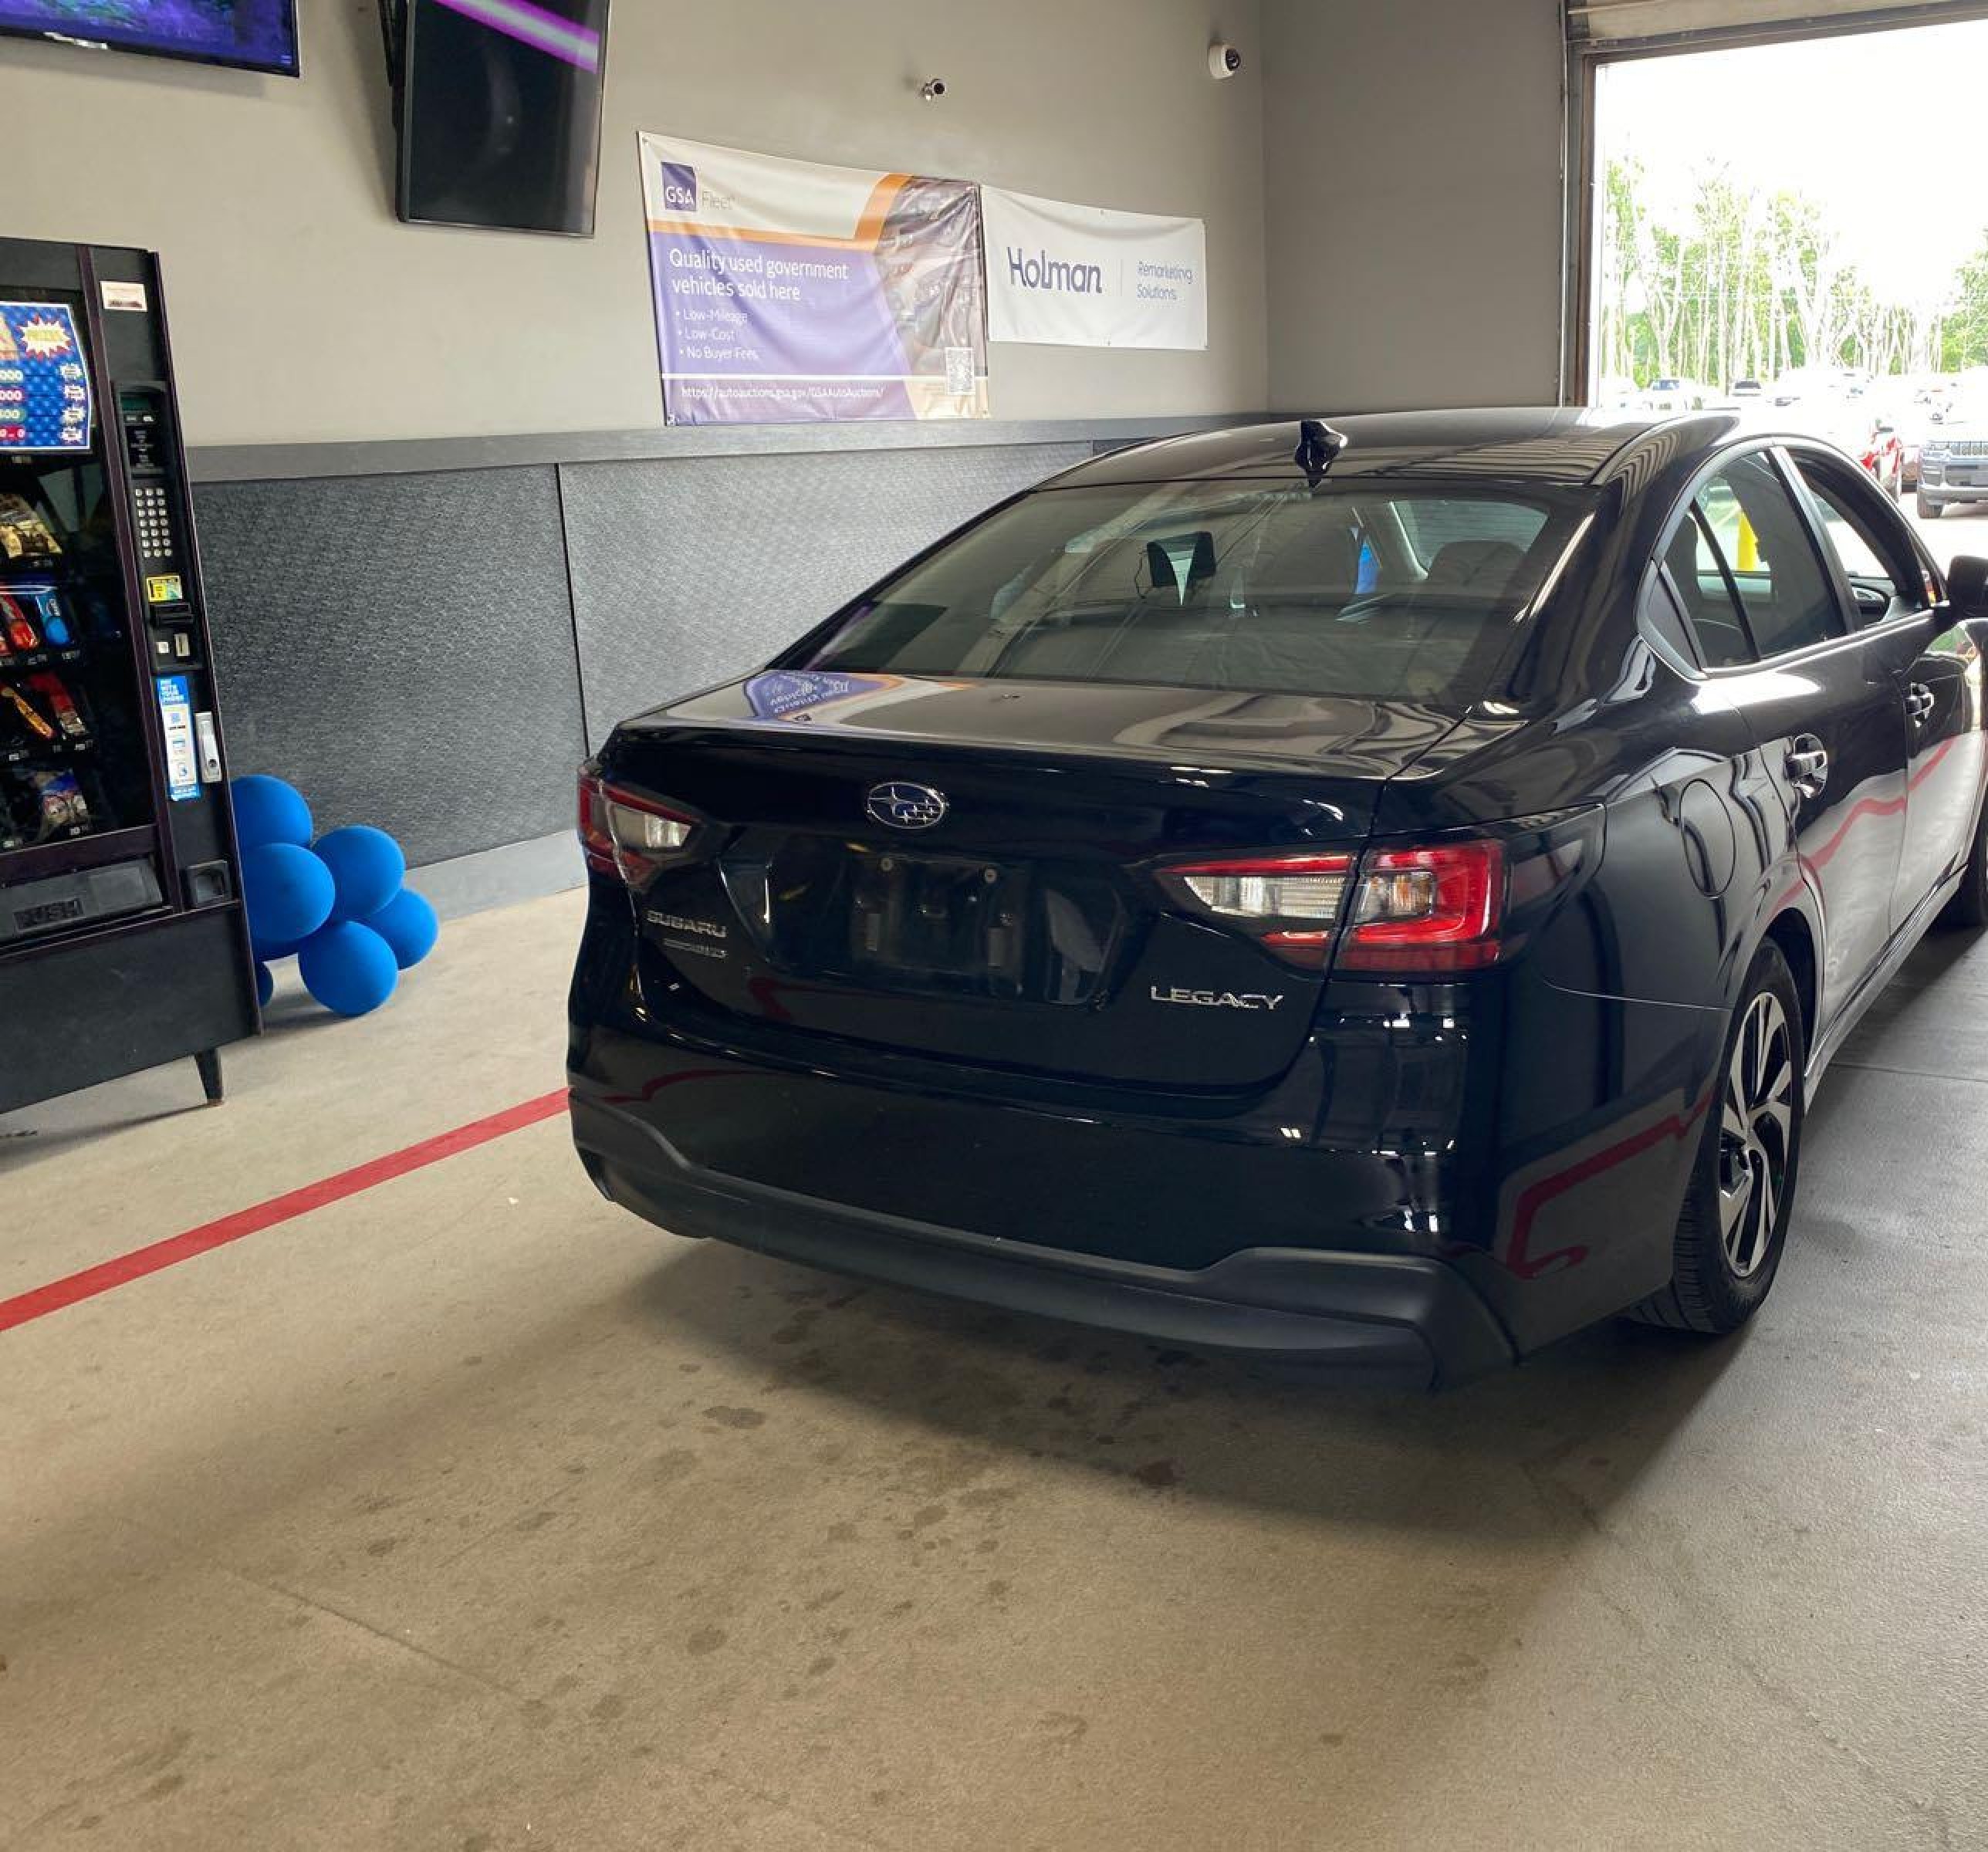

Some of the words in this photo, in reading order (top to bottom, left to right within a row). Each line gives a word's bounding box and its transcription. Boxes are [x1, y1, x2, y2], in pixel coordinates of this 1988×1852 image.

[666, 186, 694, 204] GSA
[669, 248, 724, 274] Quality
[730, 255, 762, 272] used
[766, 259, 848, 279] government
[1007, 246, 1103, 293] Holman
[1138, 261, 1193, 284] Remarketing
[672, 275, 734, 296] vehicles
[738, 279, 766, 297] sold
[770, 280, 800, 300] here
[1137, 284, 1177, 299] Solutions
[683, 309, 748, 325] Low-Mileage
[685, 327, 735, 341] Low-Cost
[687, 347, 703, 359] No
[704, 346, 732, 362] Buyer
[647, 910, 726, 938] SUBARU
[1151, 985, 1283, 1010] LEGACY
